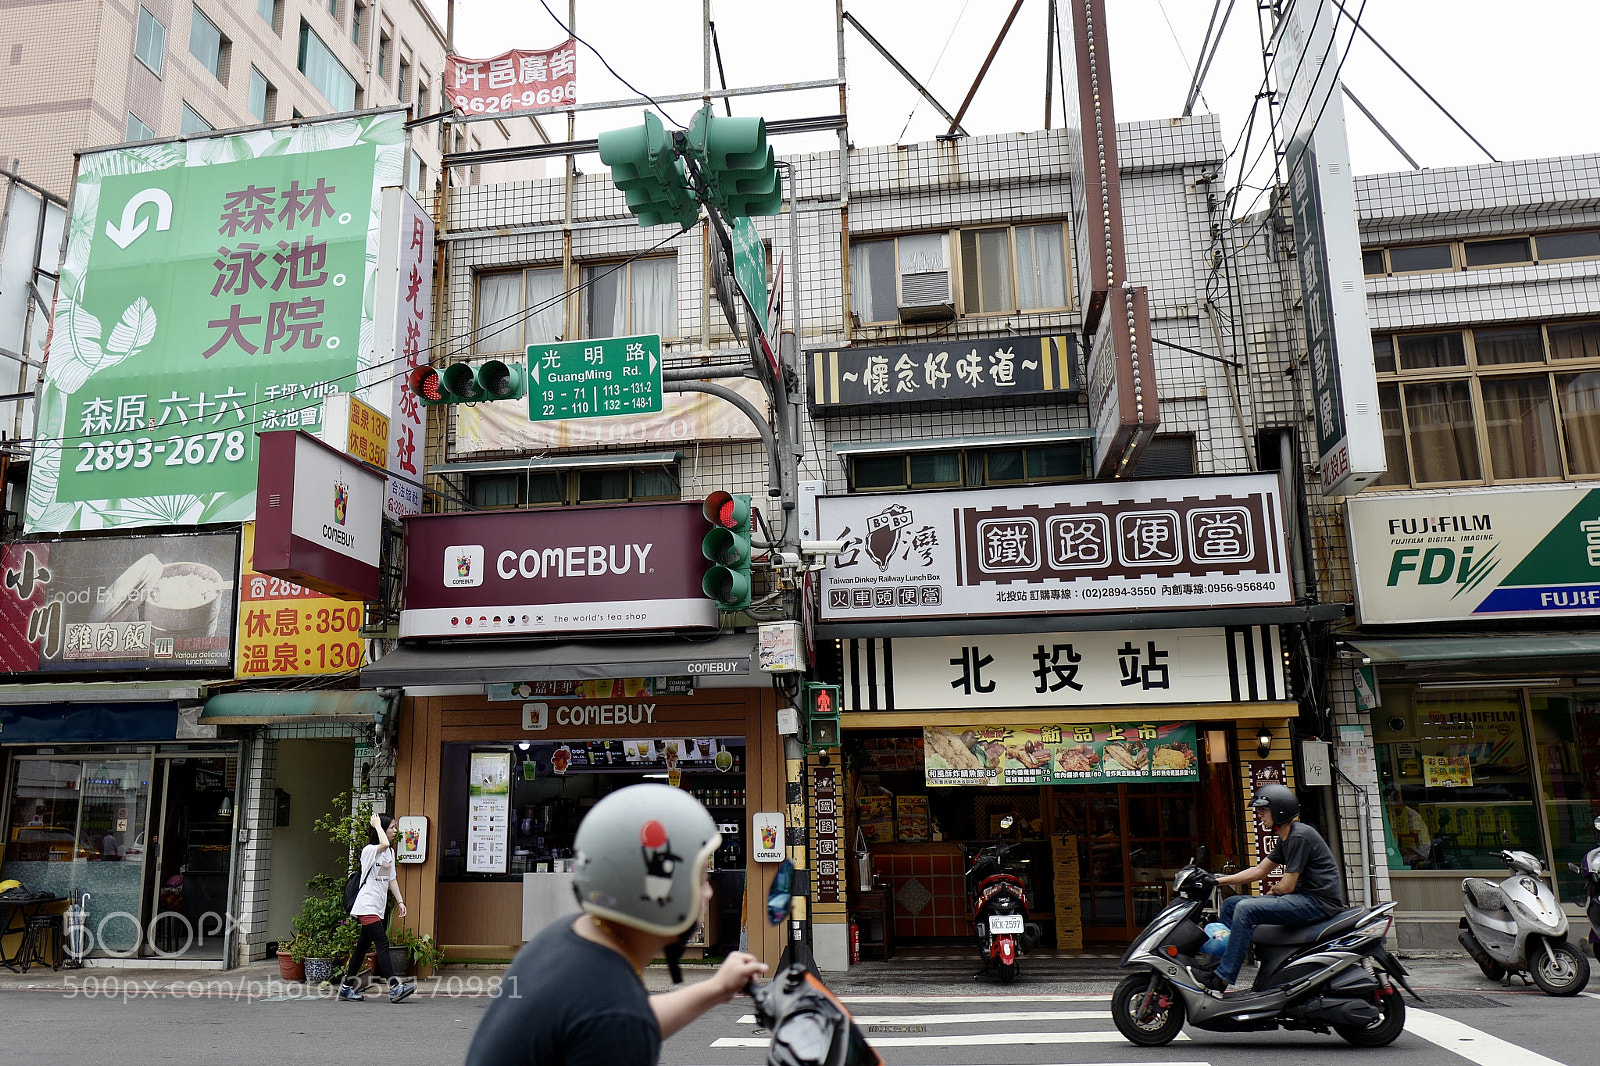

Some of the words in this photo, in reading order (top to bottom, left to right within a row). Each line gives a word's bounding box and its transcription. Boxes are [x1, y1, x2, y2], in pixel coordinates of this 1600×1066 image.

[455, 49, 575, 91] 阡邑廣告
[455, 80, 576, 114] 8626-9696
[542, 342, 645, 369] 光明路
[548, 368, 612, 383] GuangMing
[623, 365, 642, 377] Rd.
[543, 390, 554, 401] 19
[574, 387, 586, 399] 71
[603, 384, 620, 396] 113
[630, 381, 652, 394] 131-2
[80, 394, 148, 435] 森原
[158, 386, 246, 426] 六十六
[543, 404, 554, 415] 22
[572, 402, 589, 413] 110
[604, 399, 620, 410] 132
[632, 396, 652, 408] 148-1
[75, 431, 245, 472] 2893-2678
[873, 515, 889, 528] BO
[893, 515, 908, 527] BO
[1388, 514, 1492, 535] FUJIFILM
[322, 524, 355, 548] COMEBUY
[986, 513, 1245, 566] 鐵路便當
[1391, 537, 1424, 545] FUJIFILM
[1460, 534, 1493, 542] IMAGING
[497, 543, 653, 580] COMEBUY
[829, 577, 854, 585] Taiwan
[855, 576, 878, 584] Dinkey
[878, 575, 905, 584] Railway
[905, 574, 927, 582] Lunch
[832, 588, 940, 607] 火車頭便當
[996, 590, 1027, 602] 北投站
[554, 615, 569, 623] The
[573, 614, 604, 622] world's
[608, 613, 622, 621] tea
[626, 612, 647, 620] shop
[174, 651, 198, 659] Various
[199, 650, 228, 658] delicious
[687, 661, 738, 673] COMEBUY
[949, 641, 1169, 696] 北投站
[556, 703, 656, 726] COMEBUY
[980, 730, 1005, 739] NEW
[1041, 723, 1158, 744] 新品上市
[986, 769, 996, 777] 85
